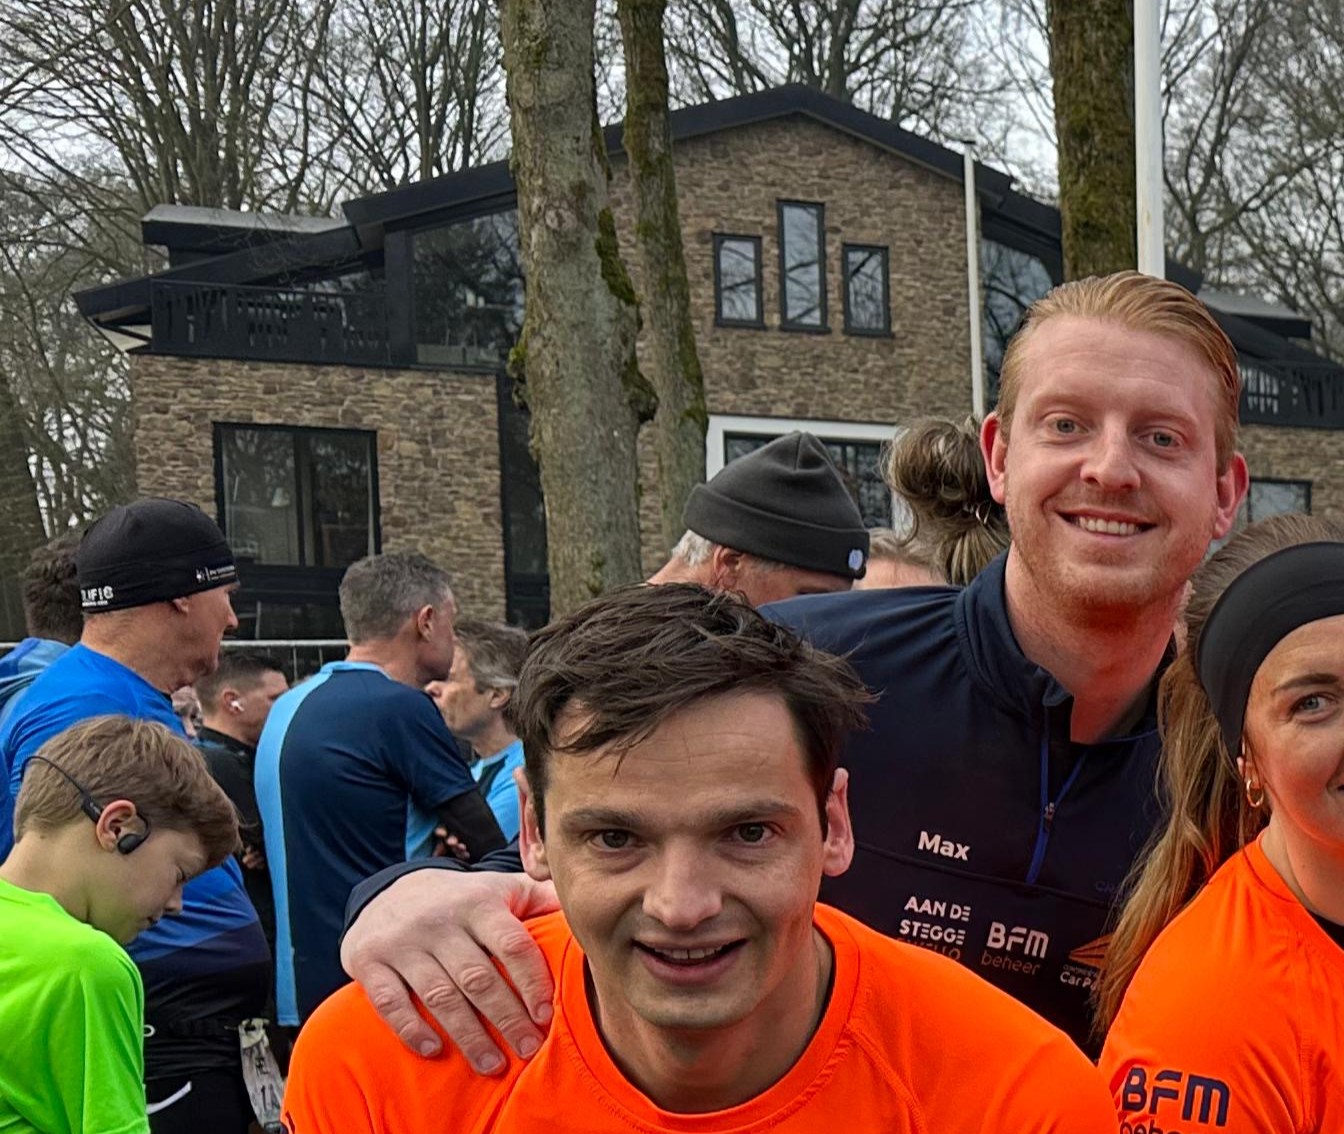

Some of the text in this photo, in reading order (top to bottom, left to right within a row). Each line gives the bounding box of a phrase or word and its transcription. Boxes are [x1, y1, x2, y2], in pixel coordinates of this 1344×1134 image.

[917, 830, 971, 861] Max
[904, 896, 972, 923] AAN DE
[899, 919, 967, 946] STEGGE
[985, 921, 1050, 959] BFM
[980, 949, 1041, 976] beheer
[1121, 1066, 1230, 1127] BFM
